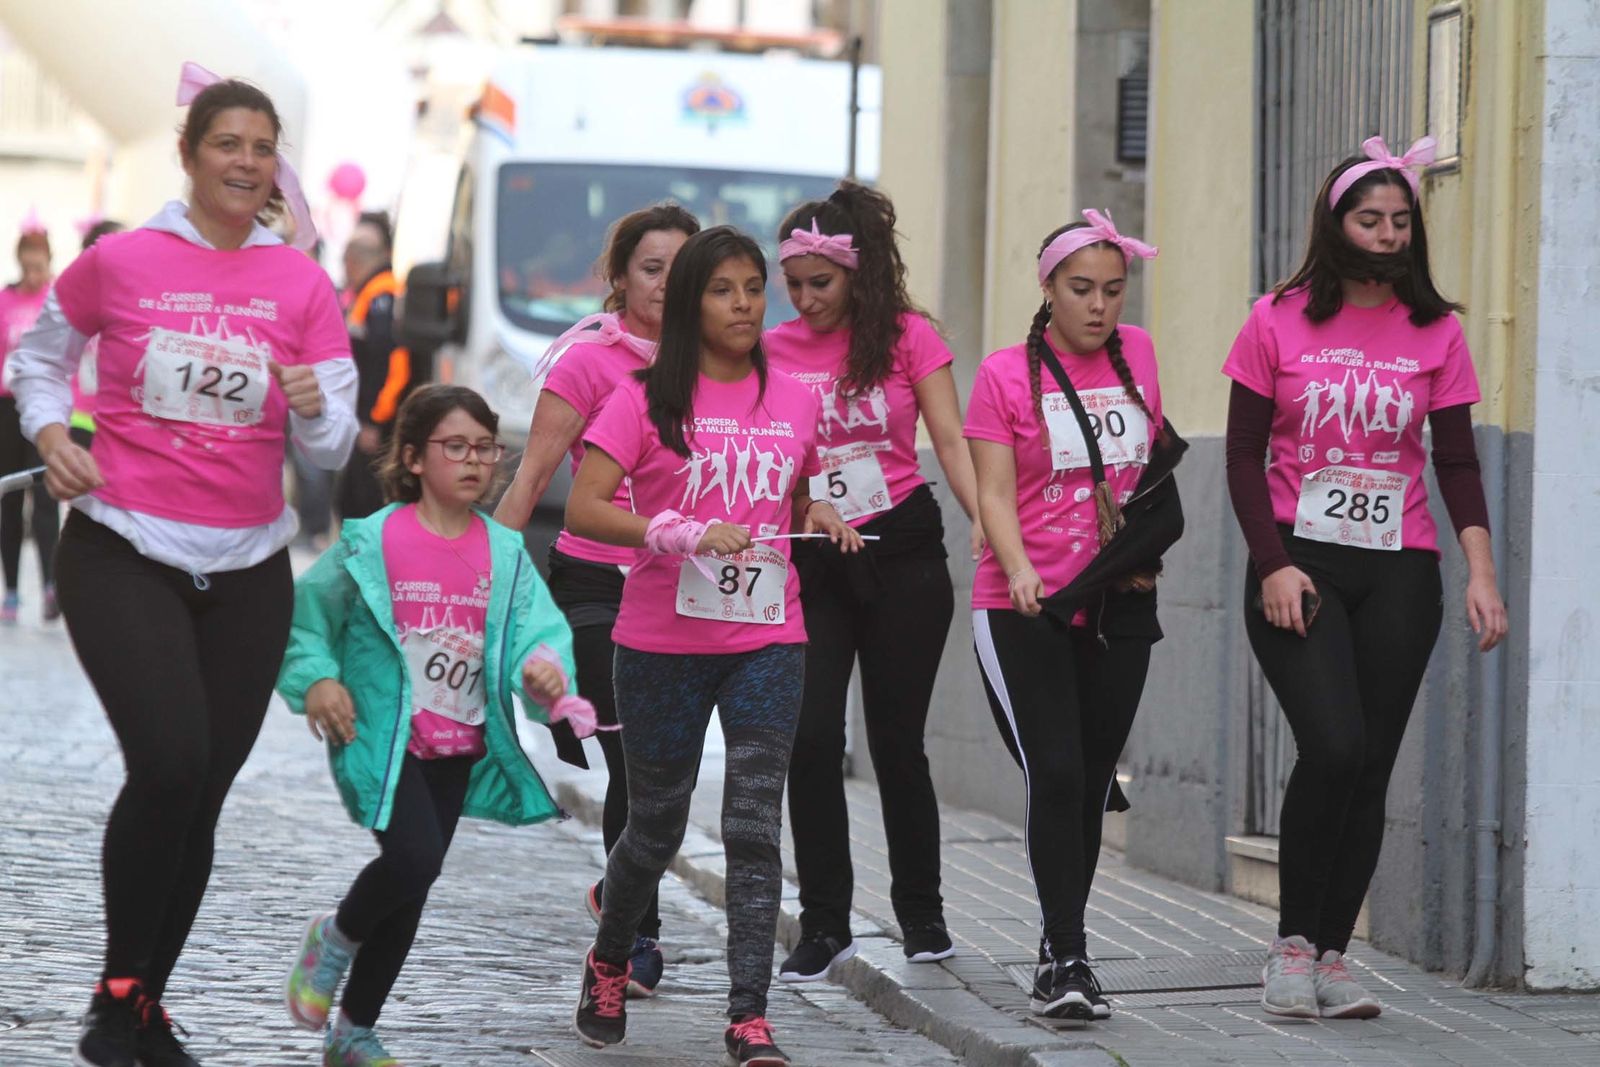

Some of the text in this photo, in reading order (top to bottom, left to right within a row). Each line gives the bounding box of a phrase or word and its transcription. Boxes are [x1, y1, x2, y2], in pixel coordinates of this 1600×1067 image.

[138, 298, 155, 308] DE
[156, 301, 172, 311] LA
[173, 302, 213, 313] MUJER
[223, 304, 278, 321] RUNNING
[161, 292, 277, 310] CARRERA PINK
[1301, 354, 1314, 363] DE
[1316, 355, 1328, 363] LA
[1330, 356, 1363, 367] MUJER
[1373, 360, 1420, 374] RUNNING
[1321, 347, 1419, 367] CARRERA PINK
[176, 362, 249, 402] 122
[1049, 403, 1060, 412] DE
[694, 417, 793, 430] CARRERA PINK
[706, 425, 740, 435] MUJER
[749, 427, 795, 438] RUNNING
[1322, 476, 1333, 484] LA
[1334, 477, 1362, 488] MUJER
[1370, 481, 1402, 492] RUNNING
[1326, 469, 1363, 481] CARRERA
[828, 471, 847, 499] 5
[1324, 489, 1390, 525] 285
[751, 554, 787, 569] RUNNING
[394, 581, 441, 592] CARRERA
[719, 565, 762, 597] 87
[406, 593, 441, 603] MUJER
[425, 652, 482, 696] 601
